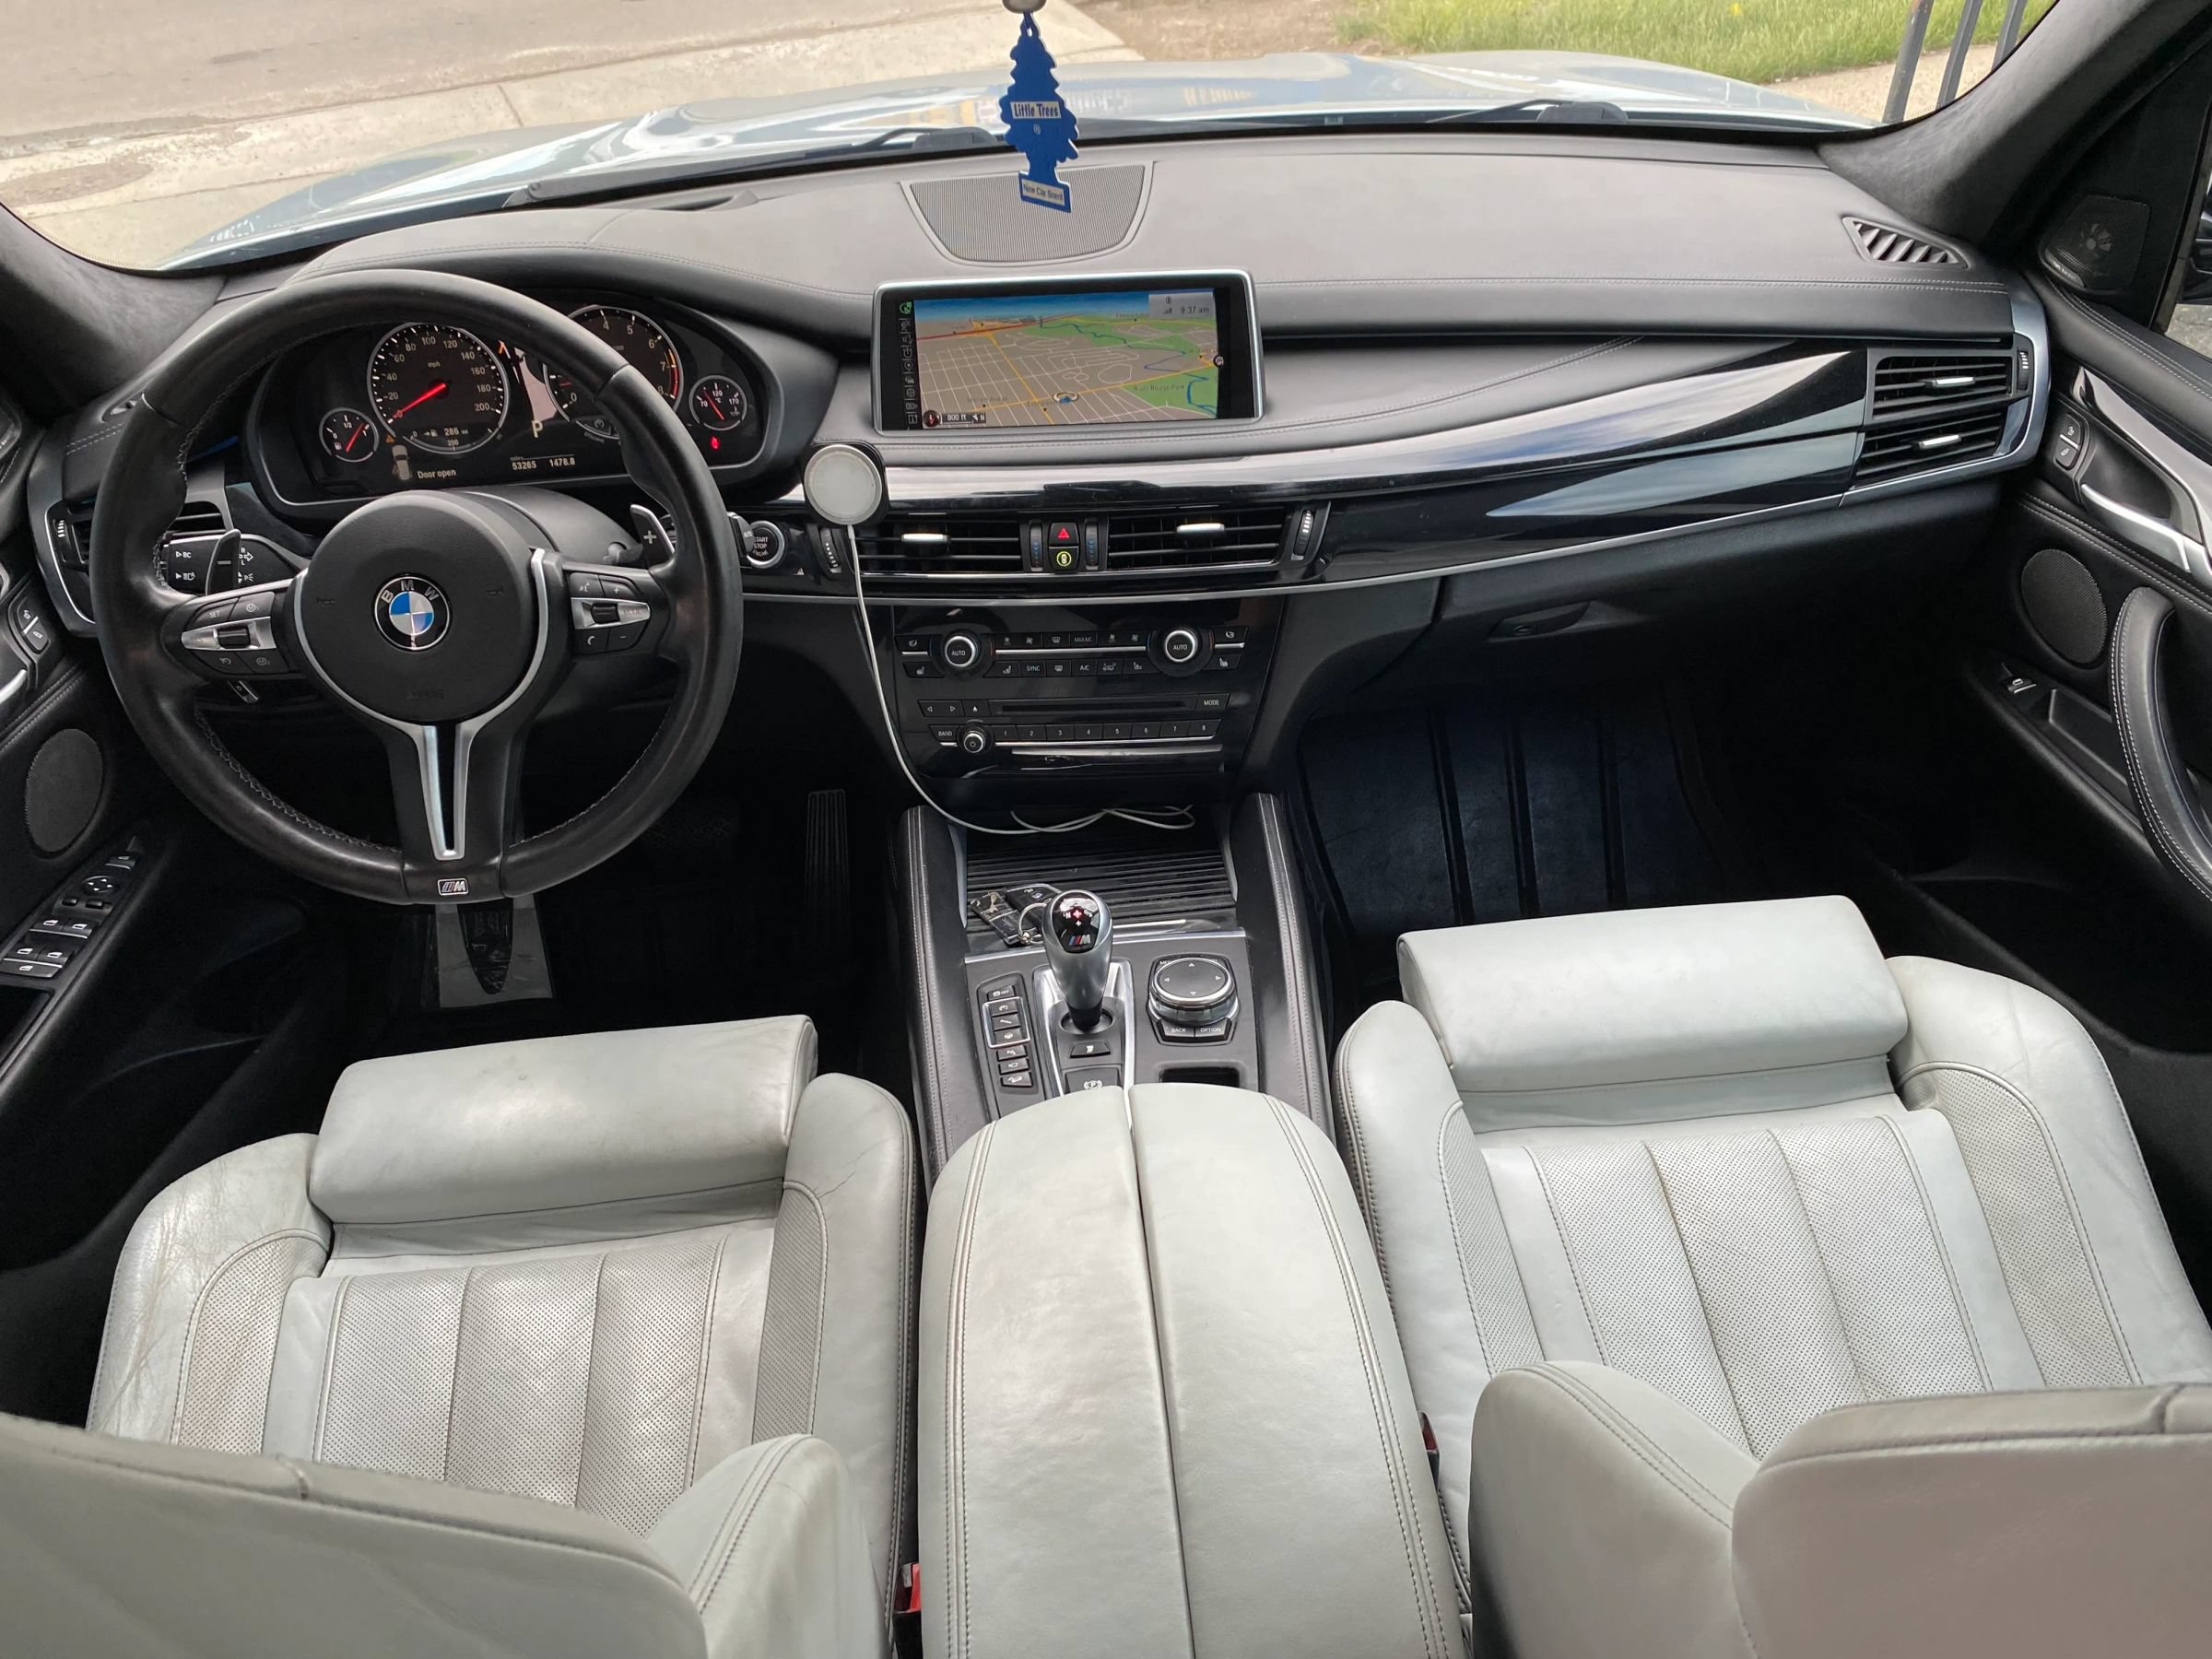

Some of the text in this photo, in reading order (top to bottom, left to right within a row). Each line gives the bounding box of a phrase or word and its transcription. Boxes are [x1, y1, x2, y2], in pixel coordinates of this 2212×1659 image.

[1014, 103, 1059, 117] Little Trees
[1023, 184, 1064, 201] New Car Scent
[603, 320, 610, 330] 4
[627, 325, 634, 335] 5
[421, 336, 436, 345] 100
[443, 339, 458, 348] 120
[649, 339, 655, 349] 6
[406, 343, 417, 352] 80
[394, 354, 406, 362] 60
[461, 351, 476, 359] 140
[660, 361, 665, 371] 7
[470, 367, 485, 375] 160
[387, 373, 397, 382] 40
[477, 383, 491, 393] 180
[657, 385, 664, 394] 8
[388, 392, 398, 400] 20
[570, 392, 578, 403] 0
[474, 403, 490, 412] 200
[531, 420, 544, 439] P
[418, 469, 457, 479] Door open
[381, 579, 440, 604] BMW
[208, 610, 221, 618] SET
